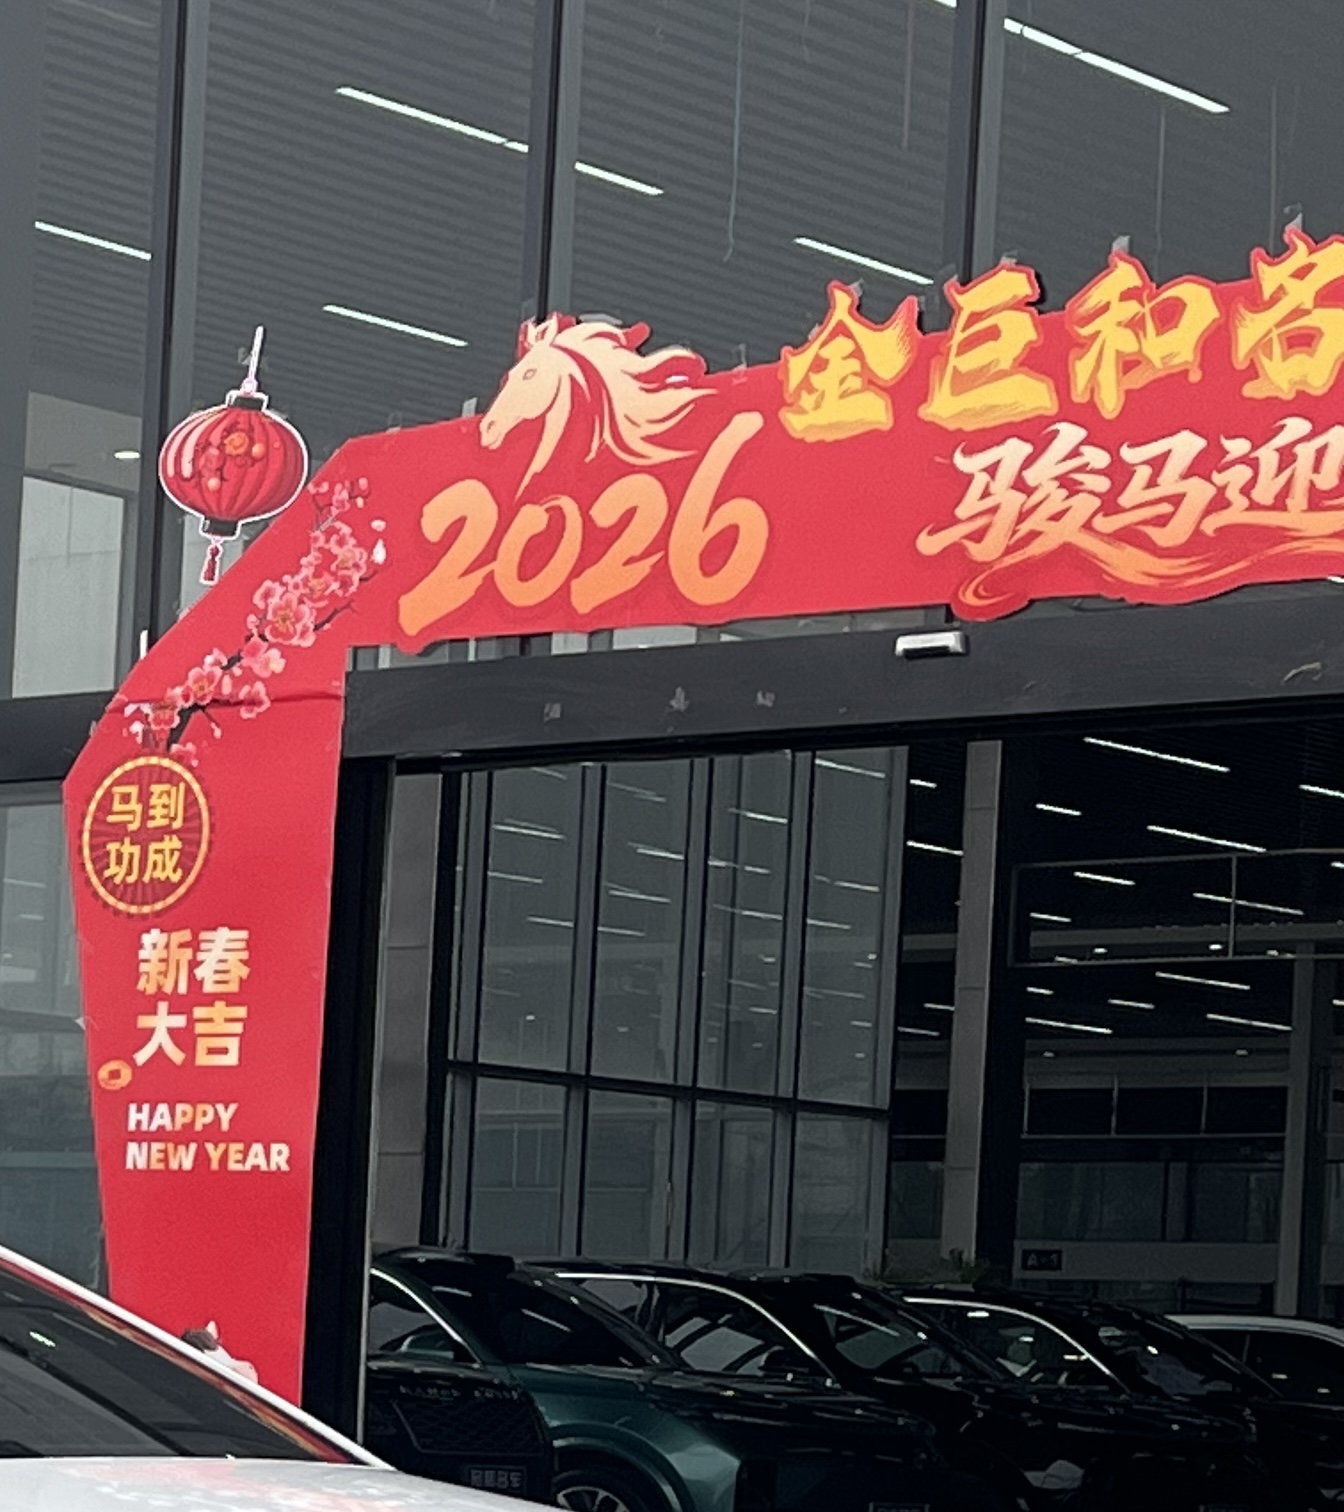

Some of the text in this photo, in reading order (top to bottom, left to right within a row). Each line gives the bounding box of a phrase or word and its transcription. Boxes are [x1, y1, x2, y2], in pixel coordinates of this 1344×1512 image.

[399, 410, 770, 637] 2026
[106, 781, 186, 832] 马到
[103, 834, 184, 885] 功成
[135, 925, 251, 997] 新春
[132, 1000, 249, 1068] 大吉
[127, 1102, 239, 1133] HAPPY
[124, 1141, 291, 1173] NEW YEAR
